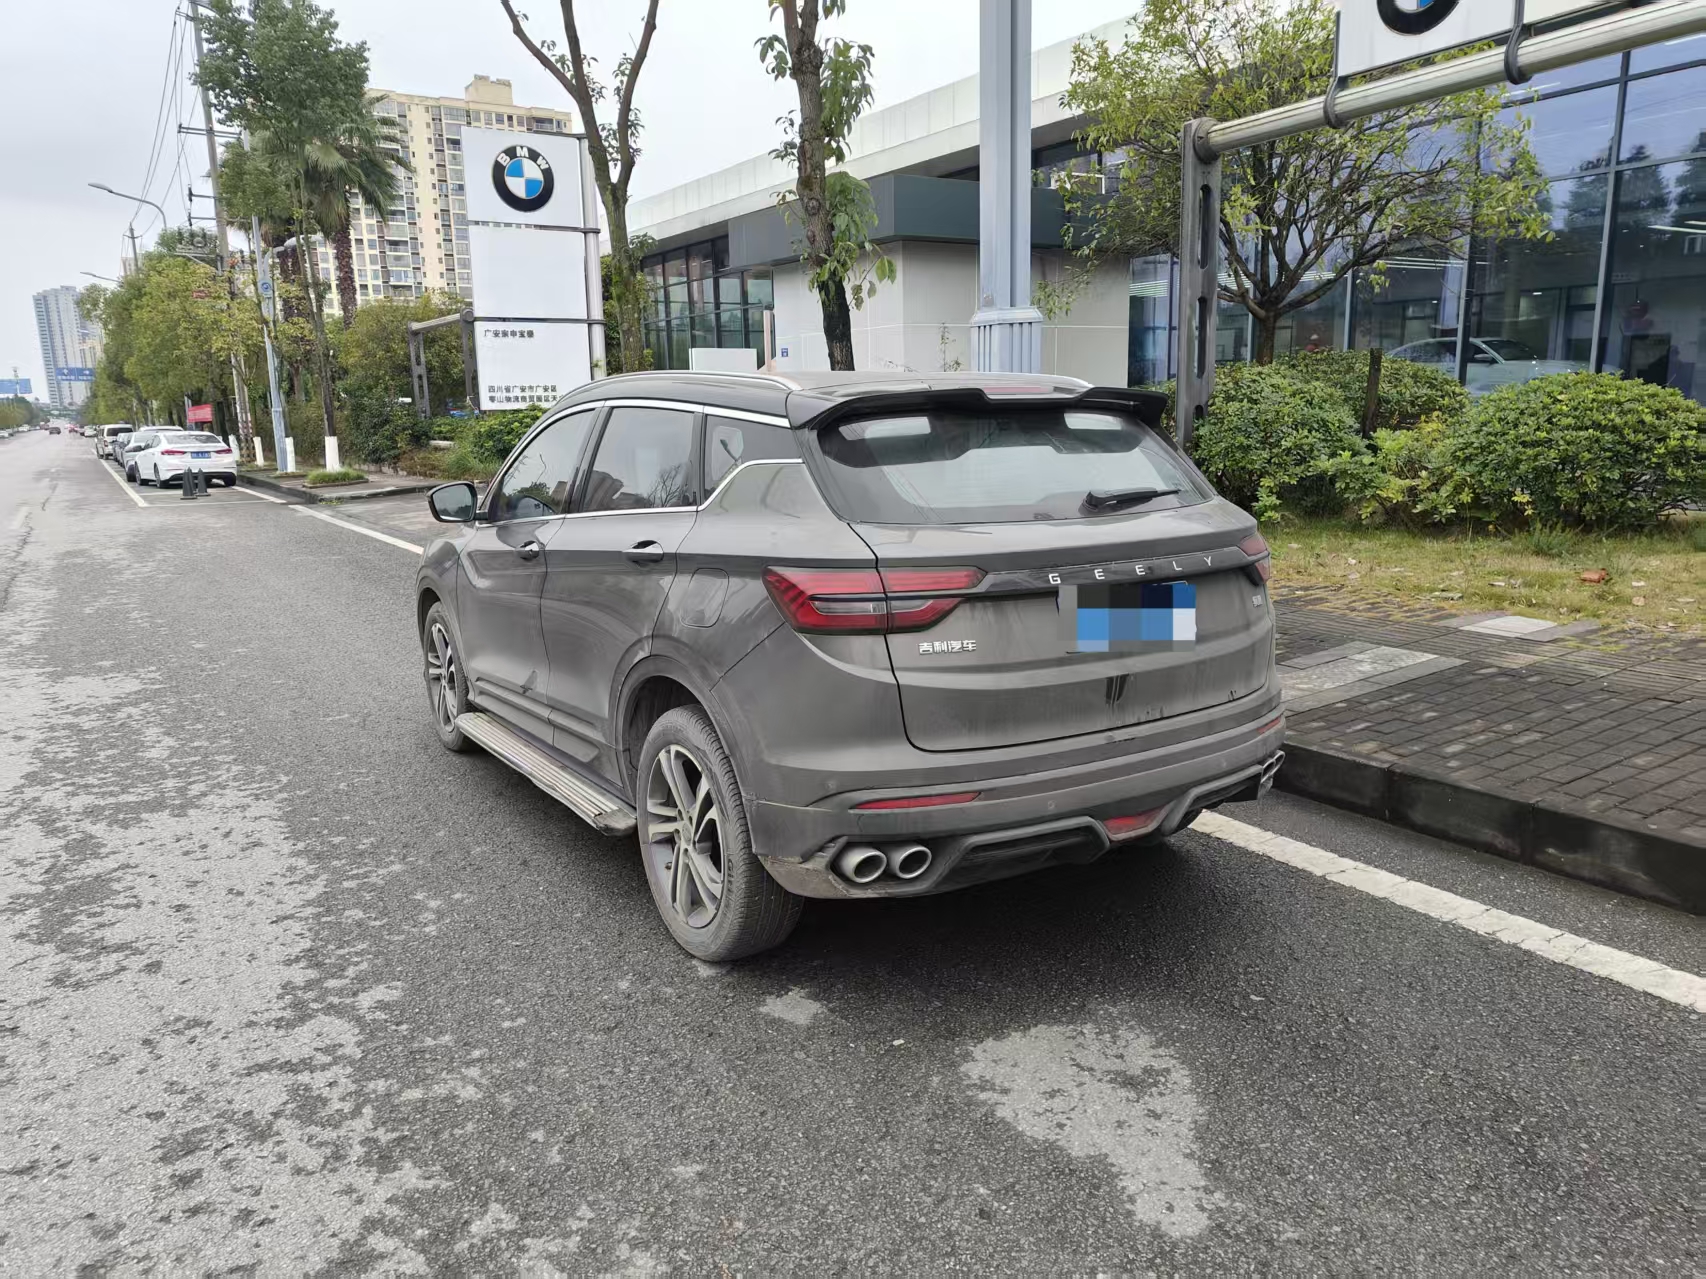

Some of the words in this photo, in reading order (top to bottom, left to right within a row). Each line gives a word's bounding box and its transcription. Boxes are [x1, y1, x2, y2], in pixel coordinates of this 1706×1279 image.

[497, 146, 550, 169] BMW
[1049, 555, 1214, 585] GEELY
[918, 640, 977, 655] 吉利汽车
